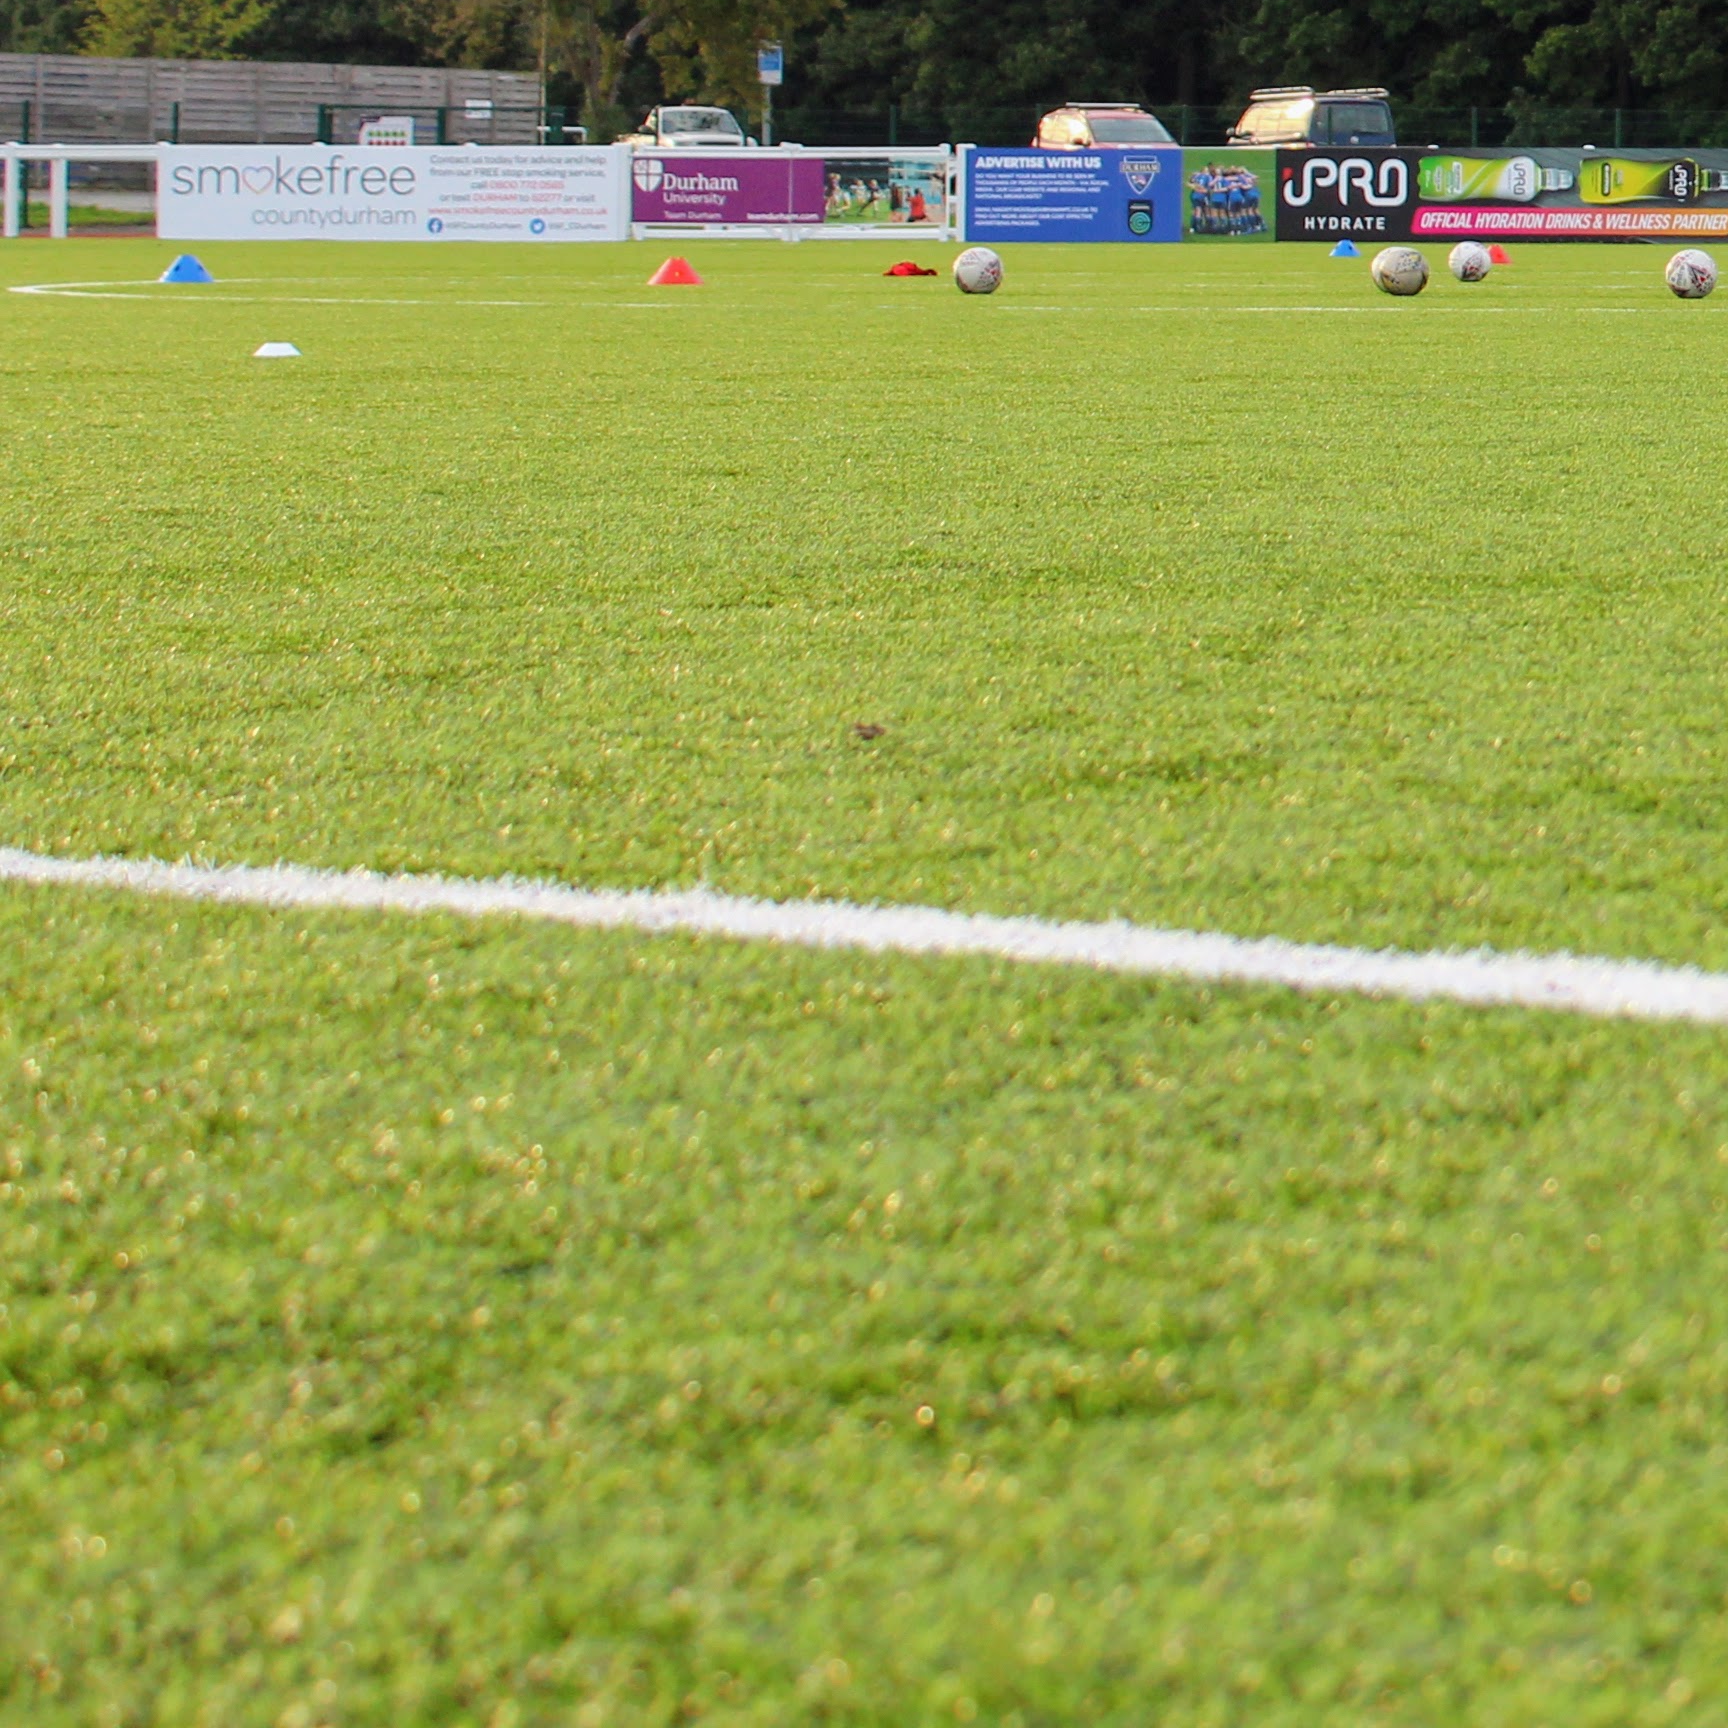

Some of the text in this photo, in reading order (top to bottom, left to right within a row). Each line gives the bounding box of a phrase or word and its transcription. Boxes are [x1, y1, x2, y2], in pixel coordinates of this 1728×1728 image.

[975, 156, 1101, 169] ADVERTISE WITH US
[663, 173, 739, 191] Durham
[664, 192, 726, 206] University
[252, 206, 417, 229] countydurham
[1304, 217, 1386, 230] HYDRATE
[1420, 212, 1728, 230] OFFICIAL HYDRATION DRINKS & WELLNESS PARTNER
